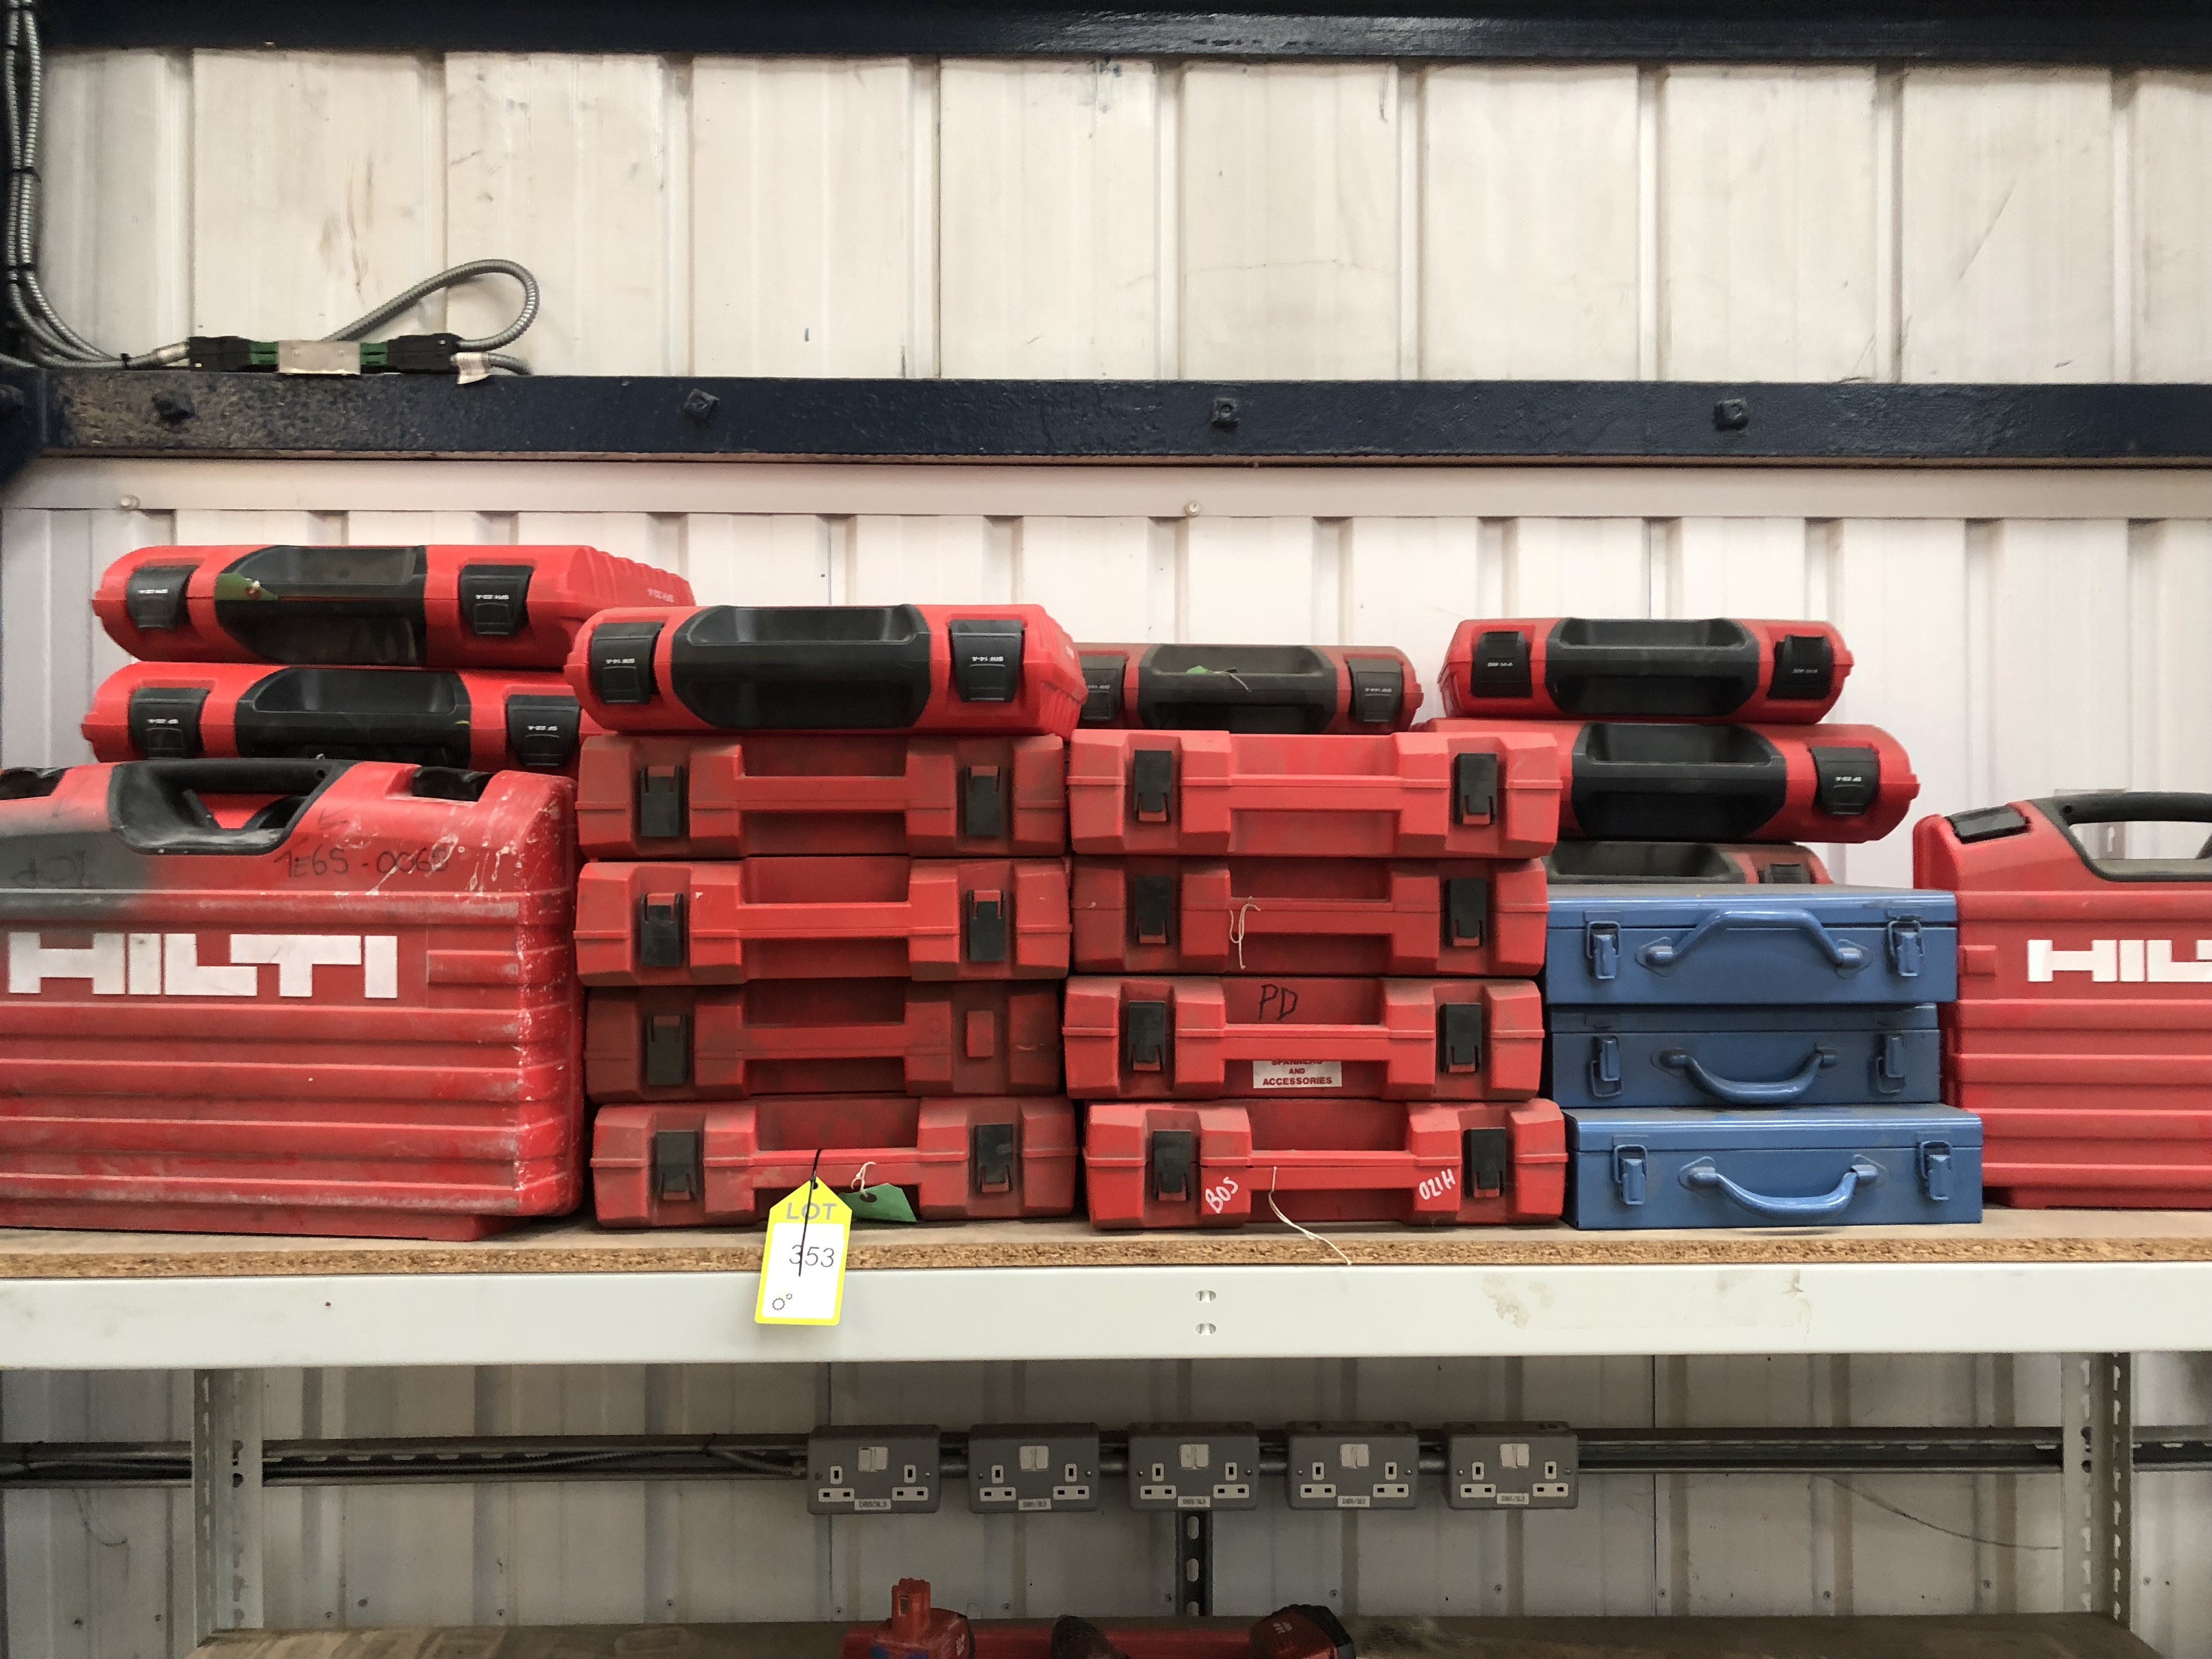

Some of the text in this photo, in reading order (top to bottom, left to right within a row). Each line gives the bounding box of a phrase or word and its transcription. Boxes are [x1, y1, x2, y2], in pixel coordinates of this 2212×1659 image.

[8, 932, 398, 998] HILTI
[2027, 939, 2212, 983] HIL
[1259, 984, 1299, 1022] PD
[1262, 1076, 1333, 1086] ACCESSORIES
[786, 1202, 837, 1221] LOT
[789, 1244, 834, 1268] 353
